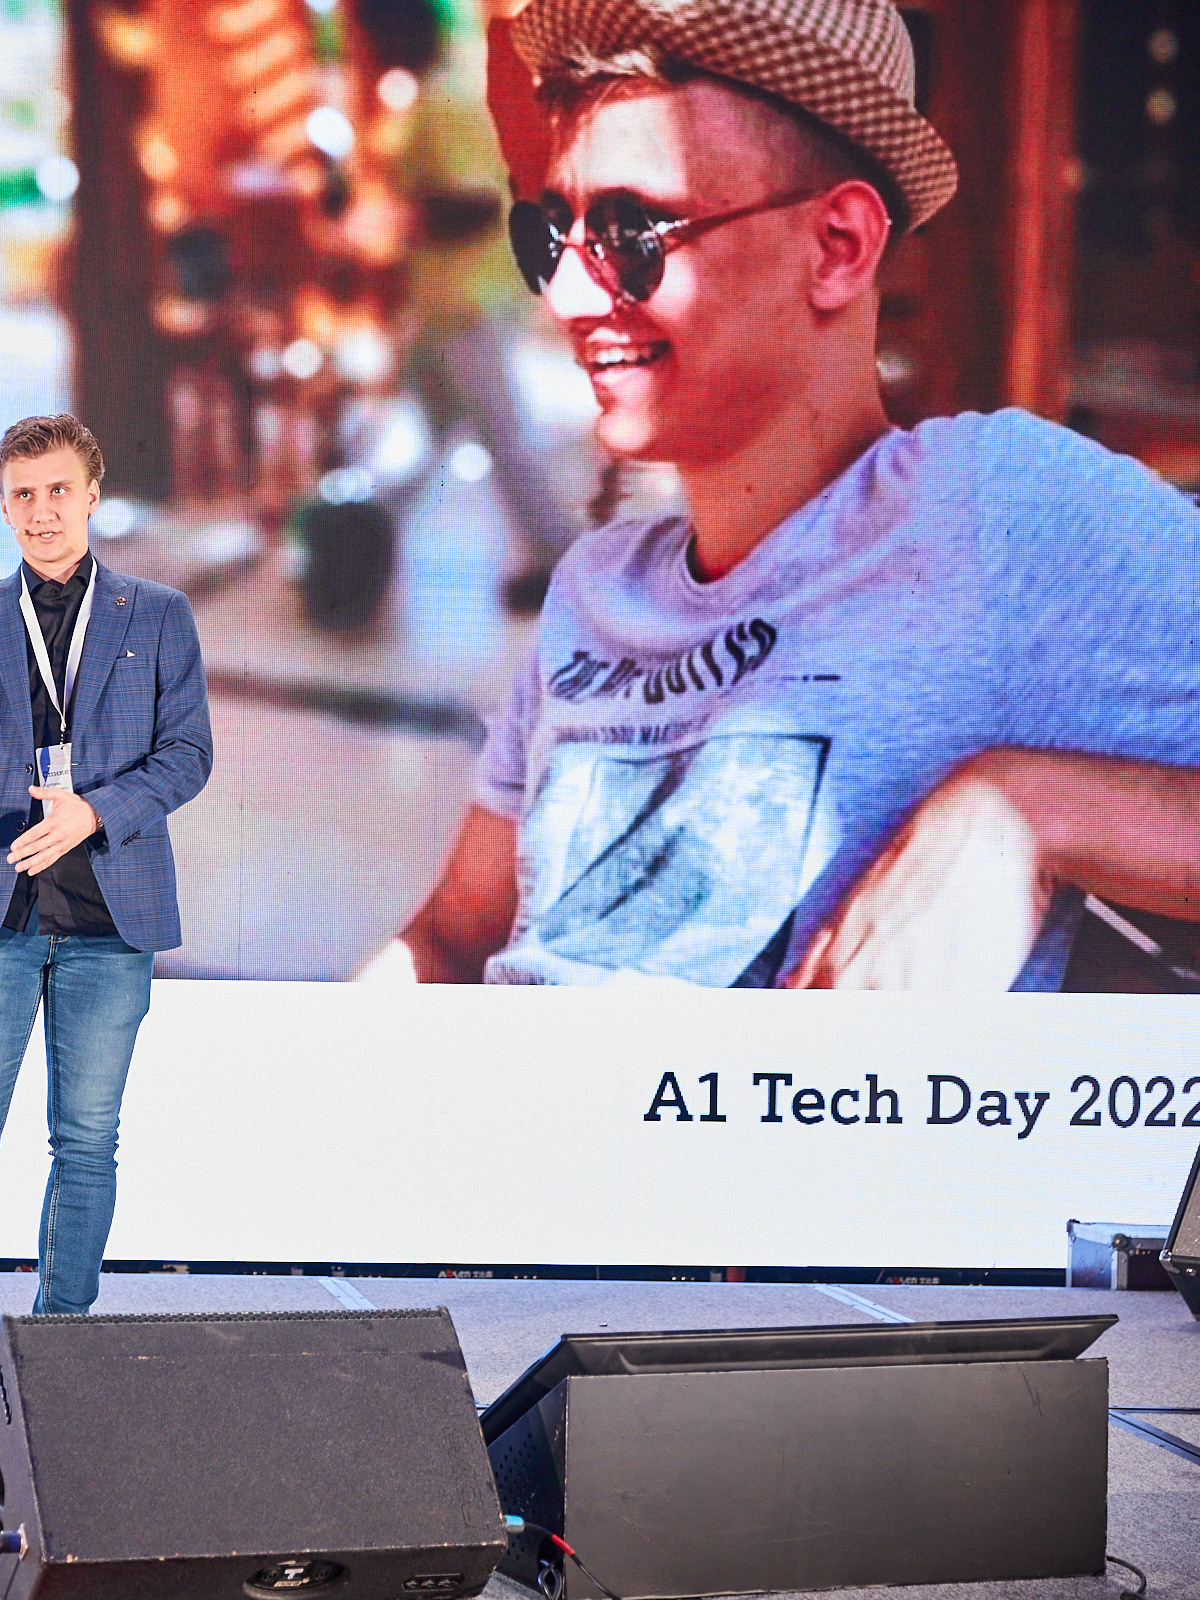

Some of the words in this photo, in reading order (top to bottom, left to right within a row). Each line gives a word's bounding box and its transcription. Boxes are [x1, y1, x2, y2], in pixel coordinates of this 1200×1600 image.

[643, 1071, 728, 1123] A1
[753, 1072, 903, 1126] Tech
[926, 1074, 1050, 1139] Day
[1069, 1075, 1200, 1129] 2022
